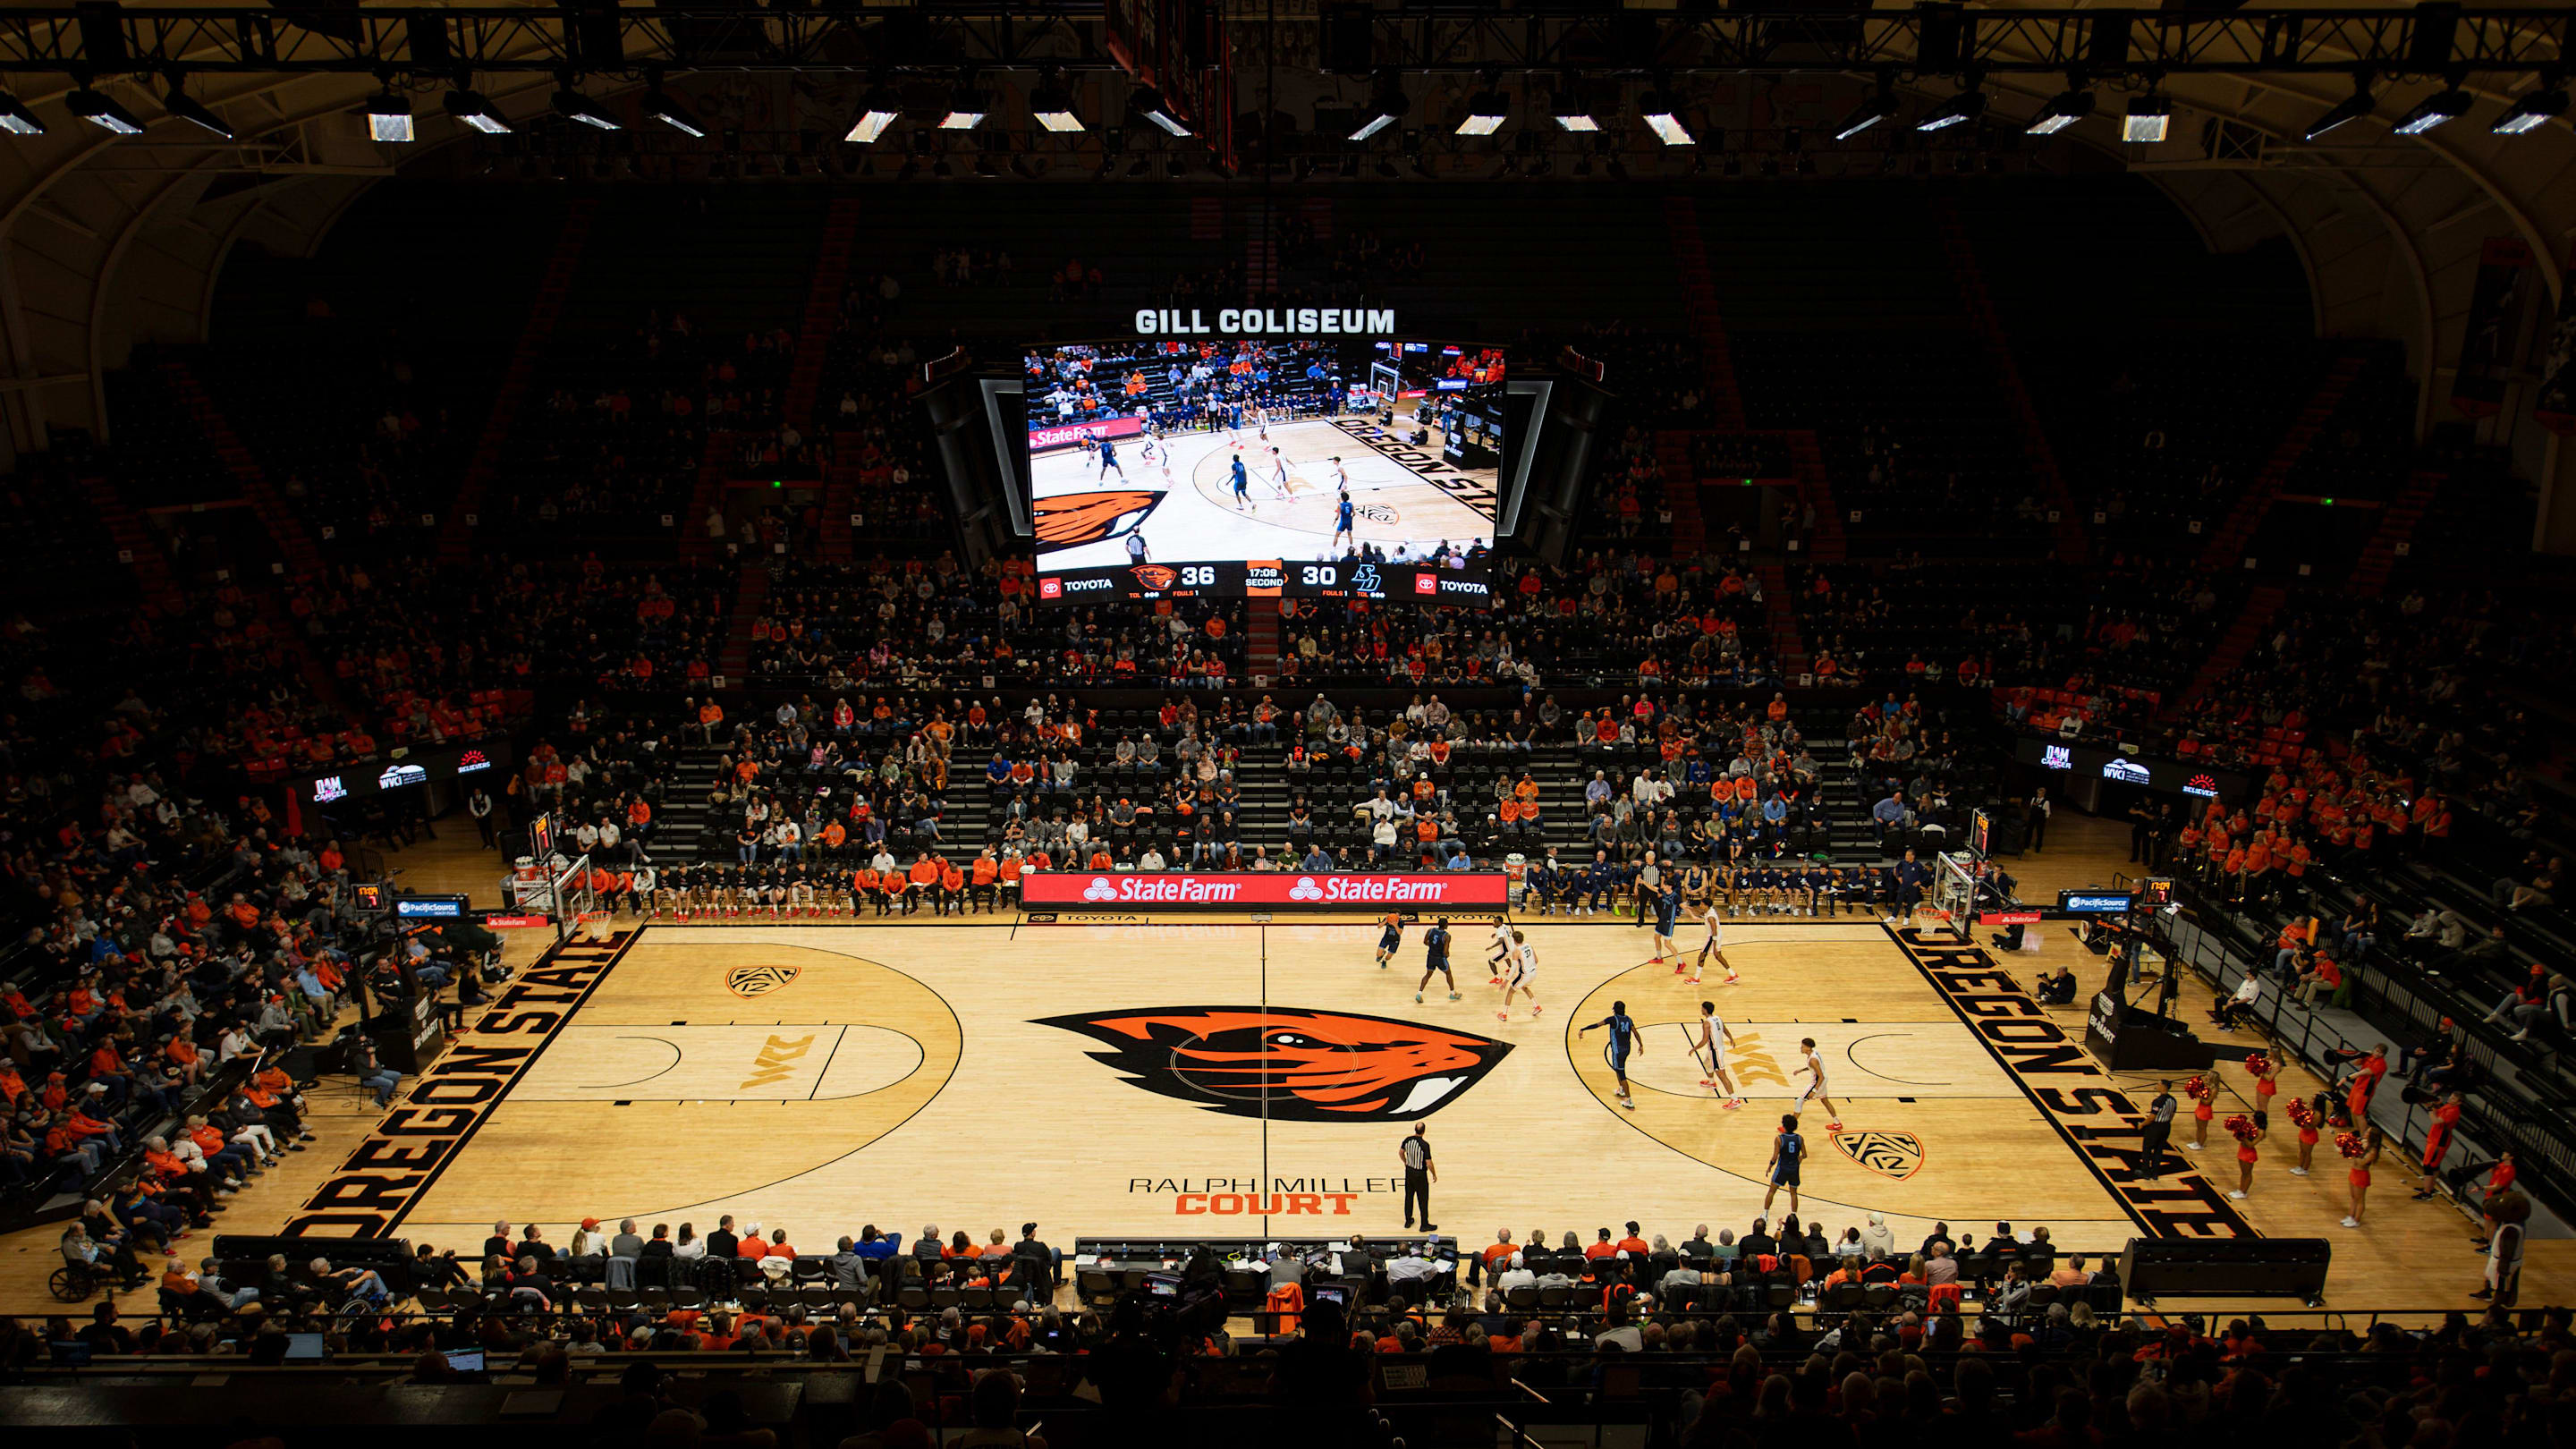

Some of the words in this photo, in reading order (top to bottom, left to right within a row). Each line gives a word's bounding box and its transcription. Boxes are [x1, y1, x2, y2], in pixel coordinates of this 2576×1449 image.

[1135, 309, 1210, 334] GILL
[1218, 309, 1394, 334] COLISEUM
[1335, 419, 1458, 474] OREGON
[1181, 565, 1216, 587] 36
[1248, 568, 1278, 579] 17:09
[1301, 565, 1337, 586] 30
[1063, 578, 1114, 592] TOYOTA
[1245, 578, 1284, 588] SECOND
[1440, 580, 1488, 595] TOYOTA
[2103, 767, 2125, 782] WVCI
[378, 775, 402, 790] WVCI
[359, 886, 379, 895] 17:09
[2151, 881, 2171, 891] 17:09
[369, 895, 377, 906] 7
[2080, 898, 2127, 908] PacificSource
[2158, 891, 2166, 901] 7
[411, 902, 457, 912] PacificSource
[741, 982, 771, 992] 12
[1896, 927, 2106, 1074] OREGON
[1620, 1021, 1630, 1032] 24
[2089, 1013, 2116, 1045] BI-MART
[414, 1016, 438, 1052] BI-MART
[278, 1045, 535, 1238] OREGON
[473, 930, 634, 1034] STATE
[1788, 1141, 1796, 1154] 6
[1873, 1157, 1910, 1170] 12
[1129, 1178, 1257, 1193] RALPH
[1175, 1193, 1358, 1216] COURT
